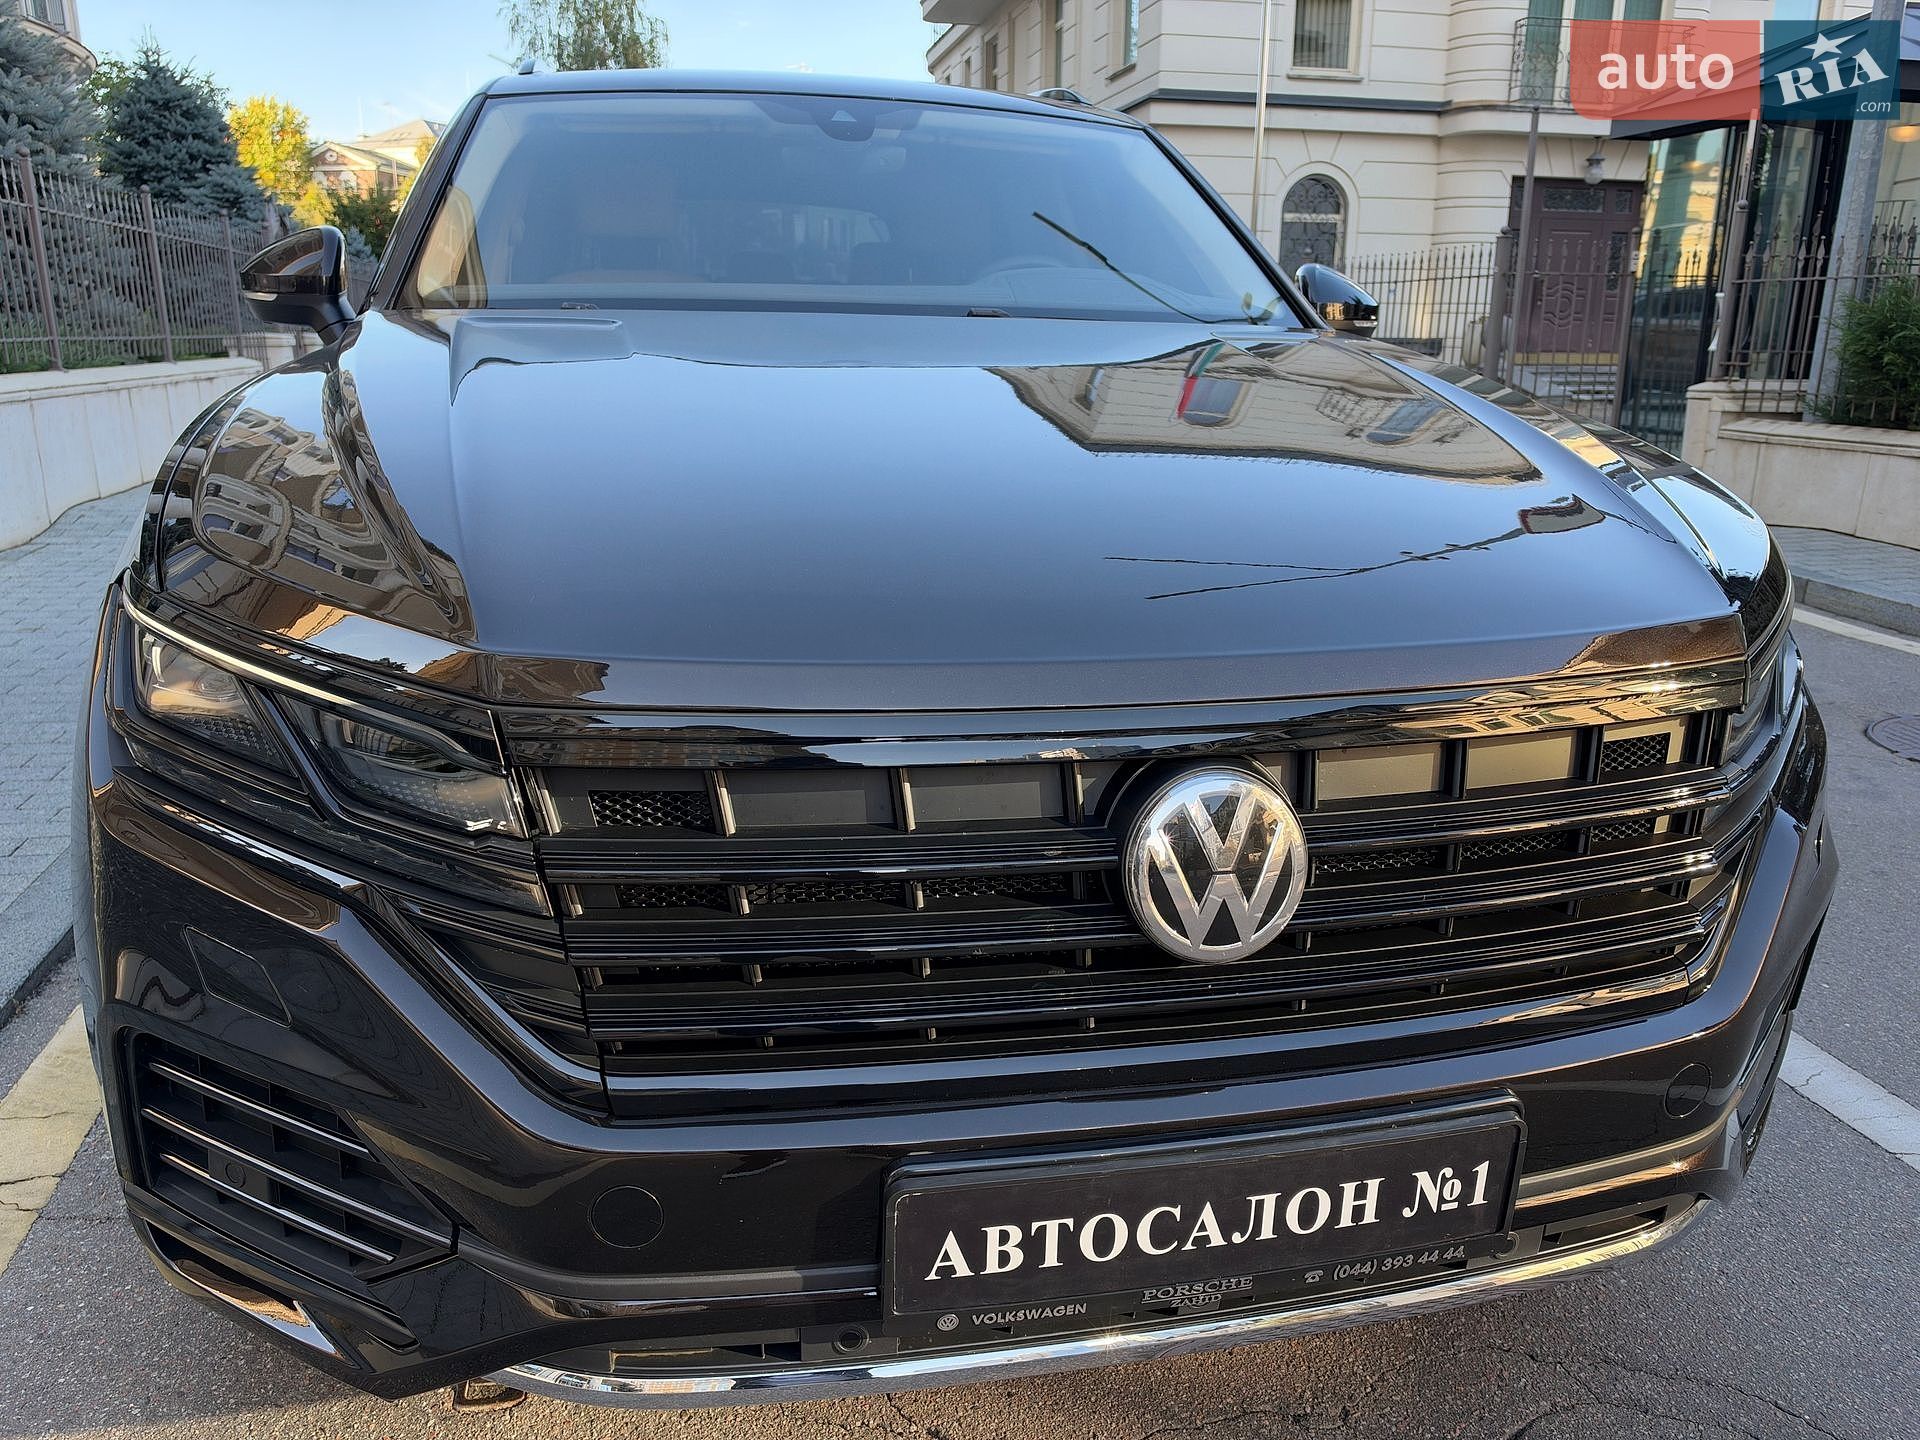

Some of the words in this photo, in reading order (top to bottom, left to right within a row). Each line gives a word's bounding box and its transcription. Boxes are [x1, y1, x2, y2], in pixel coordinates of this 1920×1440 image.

[924, 1177, 1386, 1281] АВТОСАЛОН
[1333, 1259, 1377, 1281] (044)
[1381, 1254, 1414, 1272] 393
[1417, 1250, 1439, 1265] 44
[1141, 1276, 1253, 1302] PORSCHE
[972, 1303, 1087, 1326] VOLKSWAGEN
